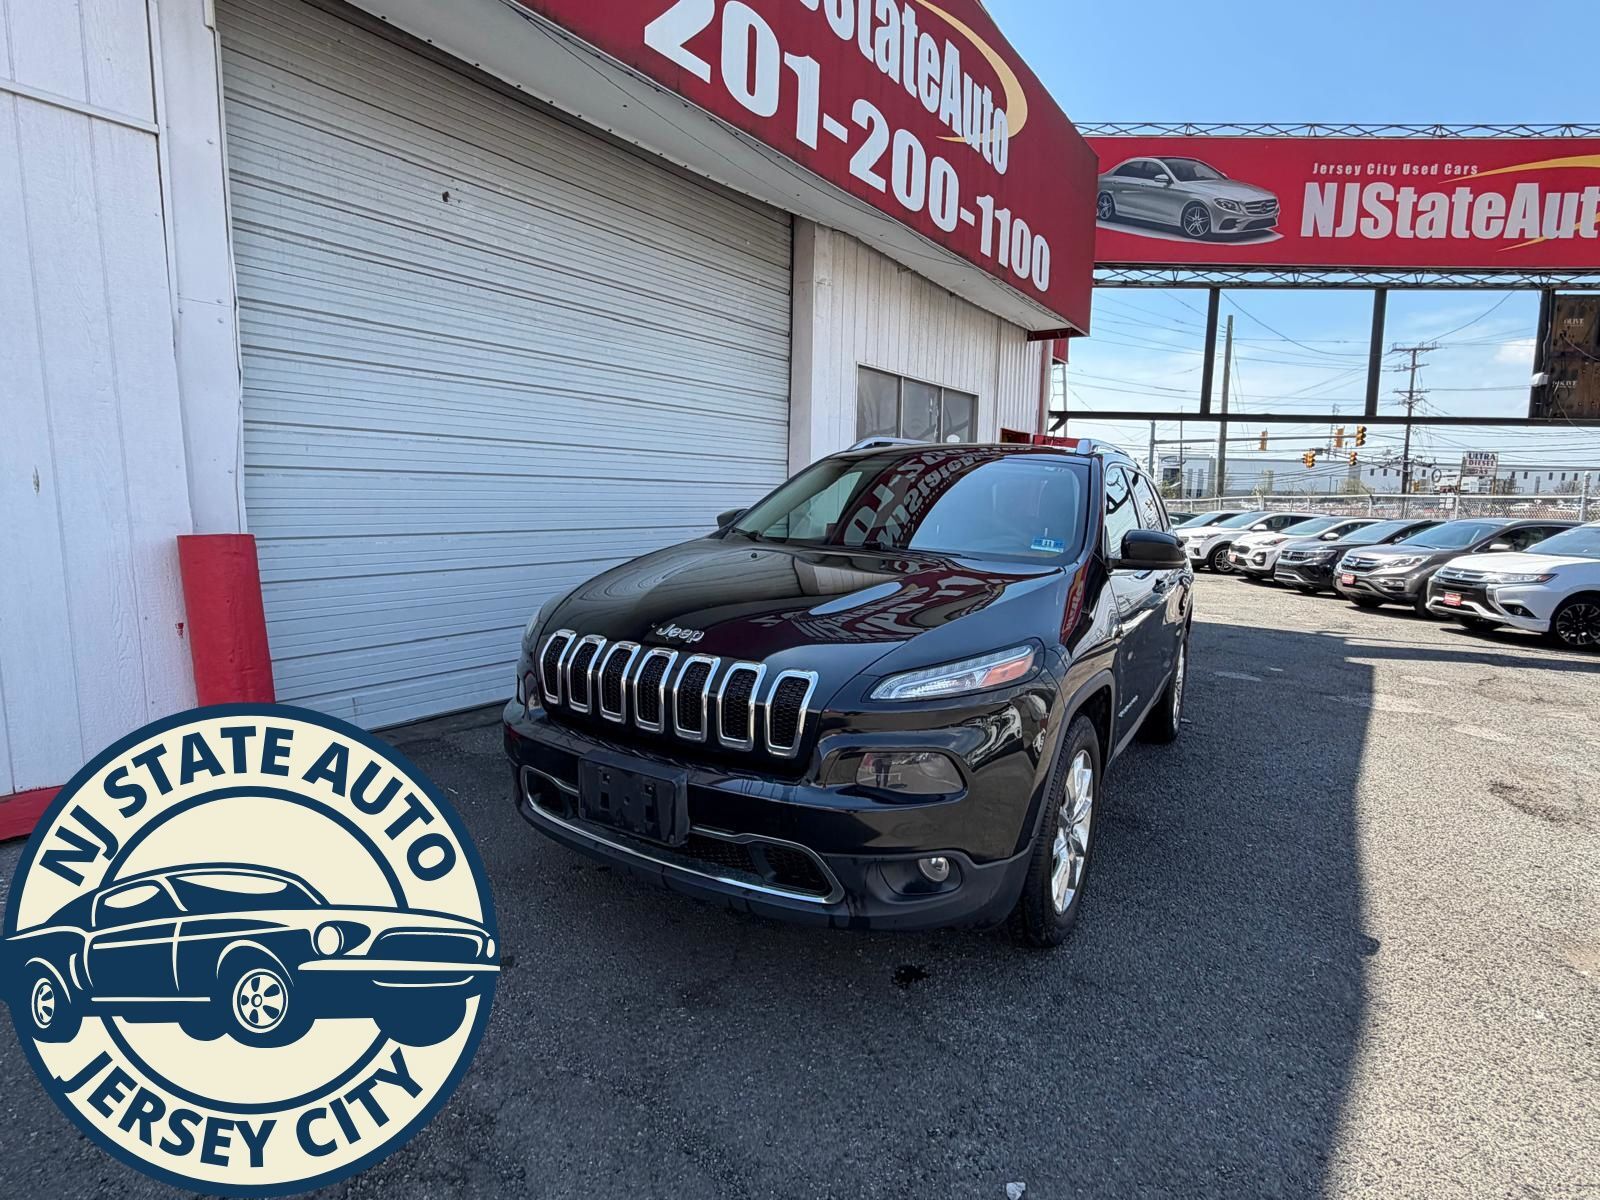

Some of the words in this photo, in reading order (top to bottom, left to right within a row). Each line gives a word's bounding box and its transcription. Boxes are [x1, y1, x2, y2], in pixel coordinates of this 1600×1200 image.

[800, 0, 1008, 175] tateAuto
[644, 0, 1051, 292] 201-200-1100
[1312, 162, 1361, 175] Jersey
[1366, 163, 1397, 175] City
[1402, 163, 1439, 175] Used
[1444, 163, 1479, 176] Cars
[1300, 182, 1600, 239] NJStateAut
[1468, 452, 1496, 460] ULTRA
[656, 623, 705, 643] Jeep
